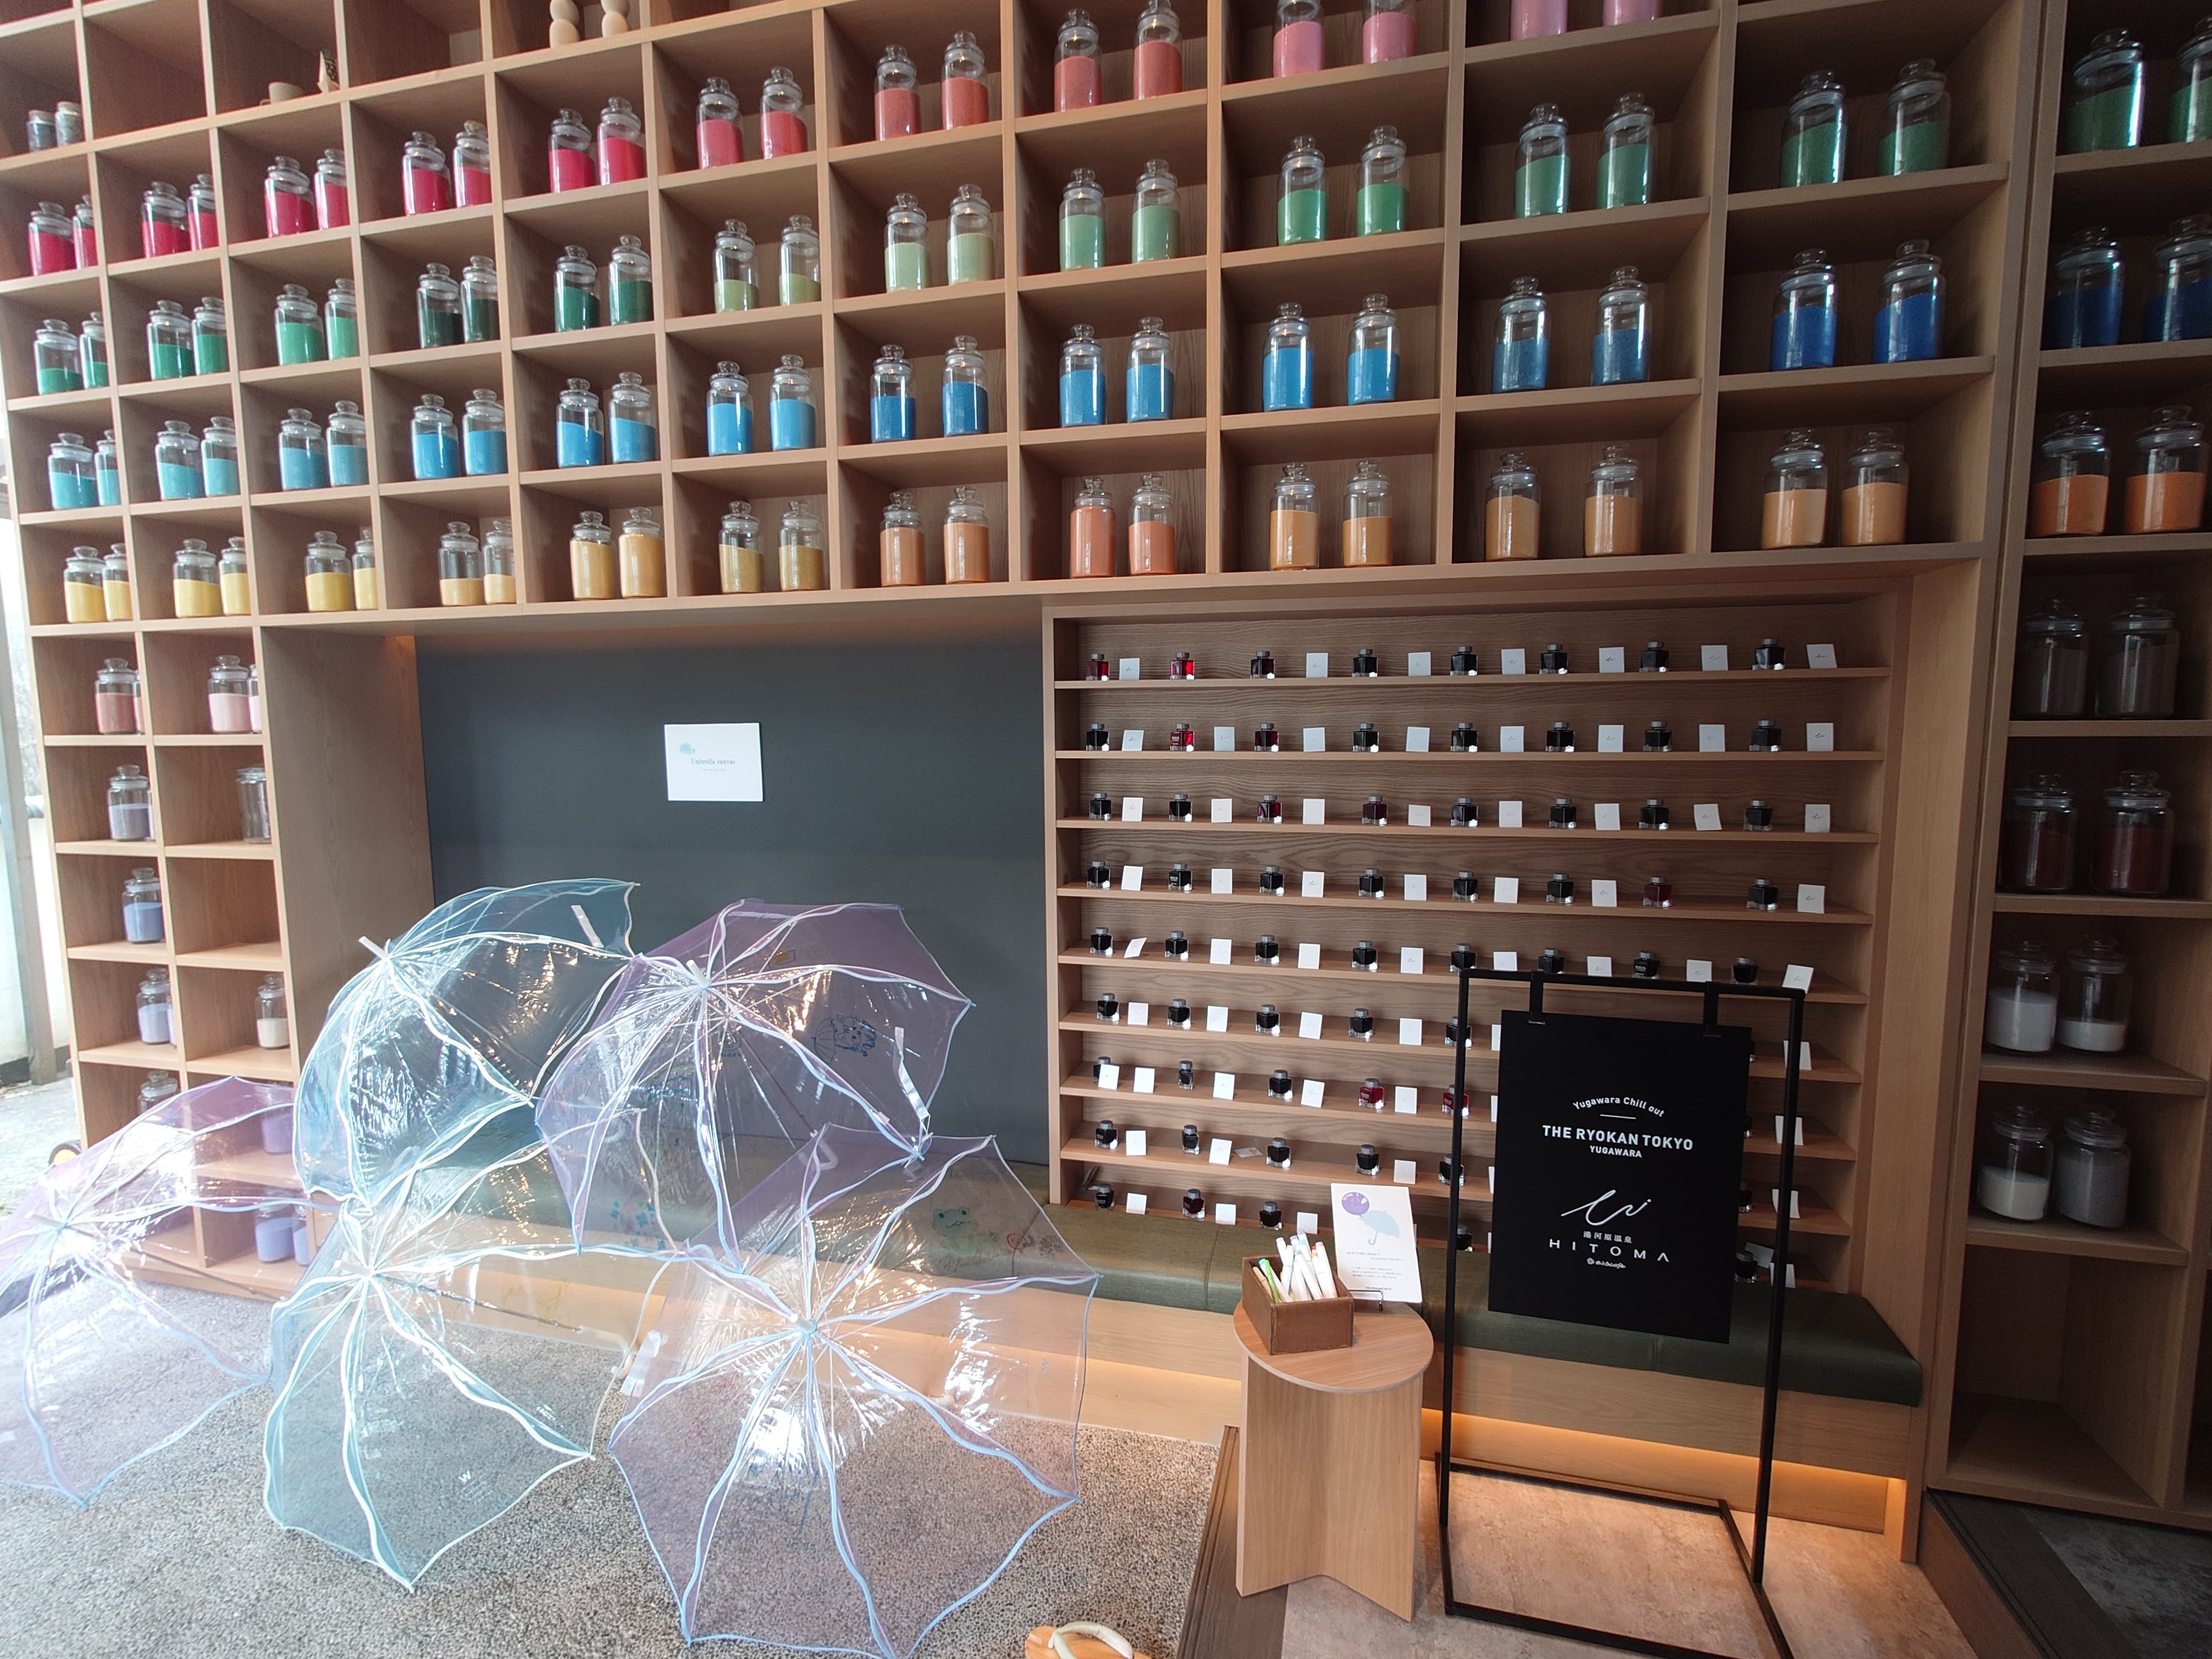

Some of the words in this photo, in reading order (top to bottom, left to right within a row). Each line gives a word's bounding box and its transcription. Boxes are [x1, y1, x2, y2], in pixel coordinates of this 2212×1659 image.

[1573, 1097, 1620, 1109] Yugawara
[1623, 1097, 1646, 1109] Chill
[1648, 1105, 1665, 1117] out
[1542, 1125, 1572, 1139] THE
[1575, 1128, 1639, 1145] RYOKAN
[1642, 1134, 1693, 1151] TOKYO
[1589, 1145, 1642, 1158] YUGAWARA
[1583, 1230, 1632, 1244] 湯河原温泉
